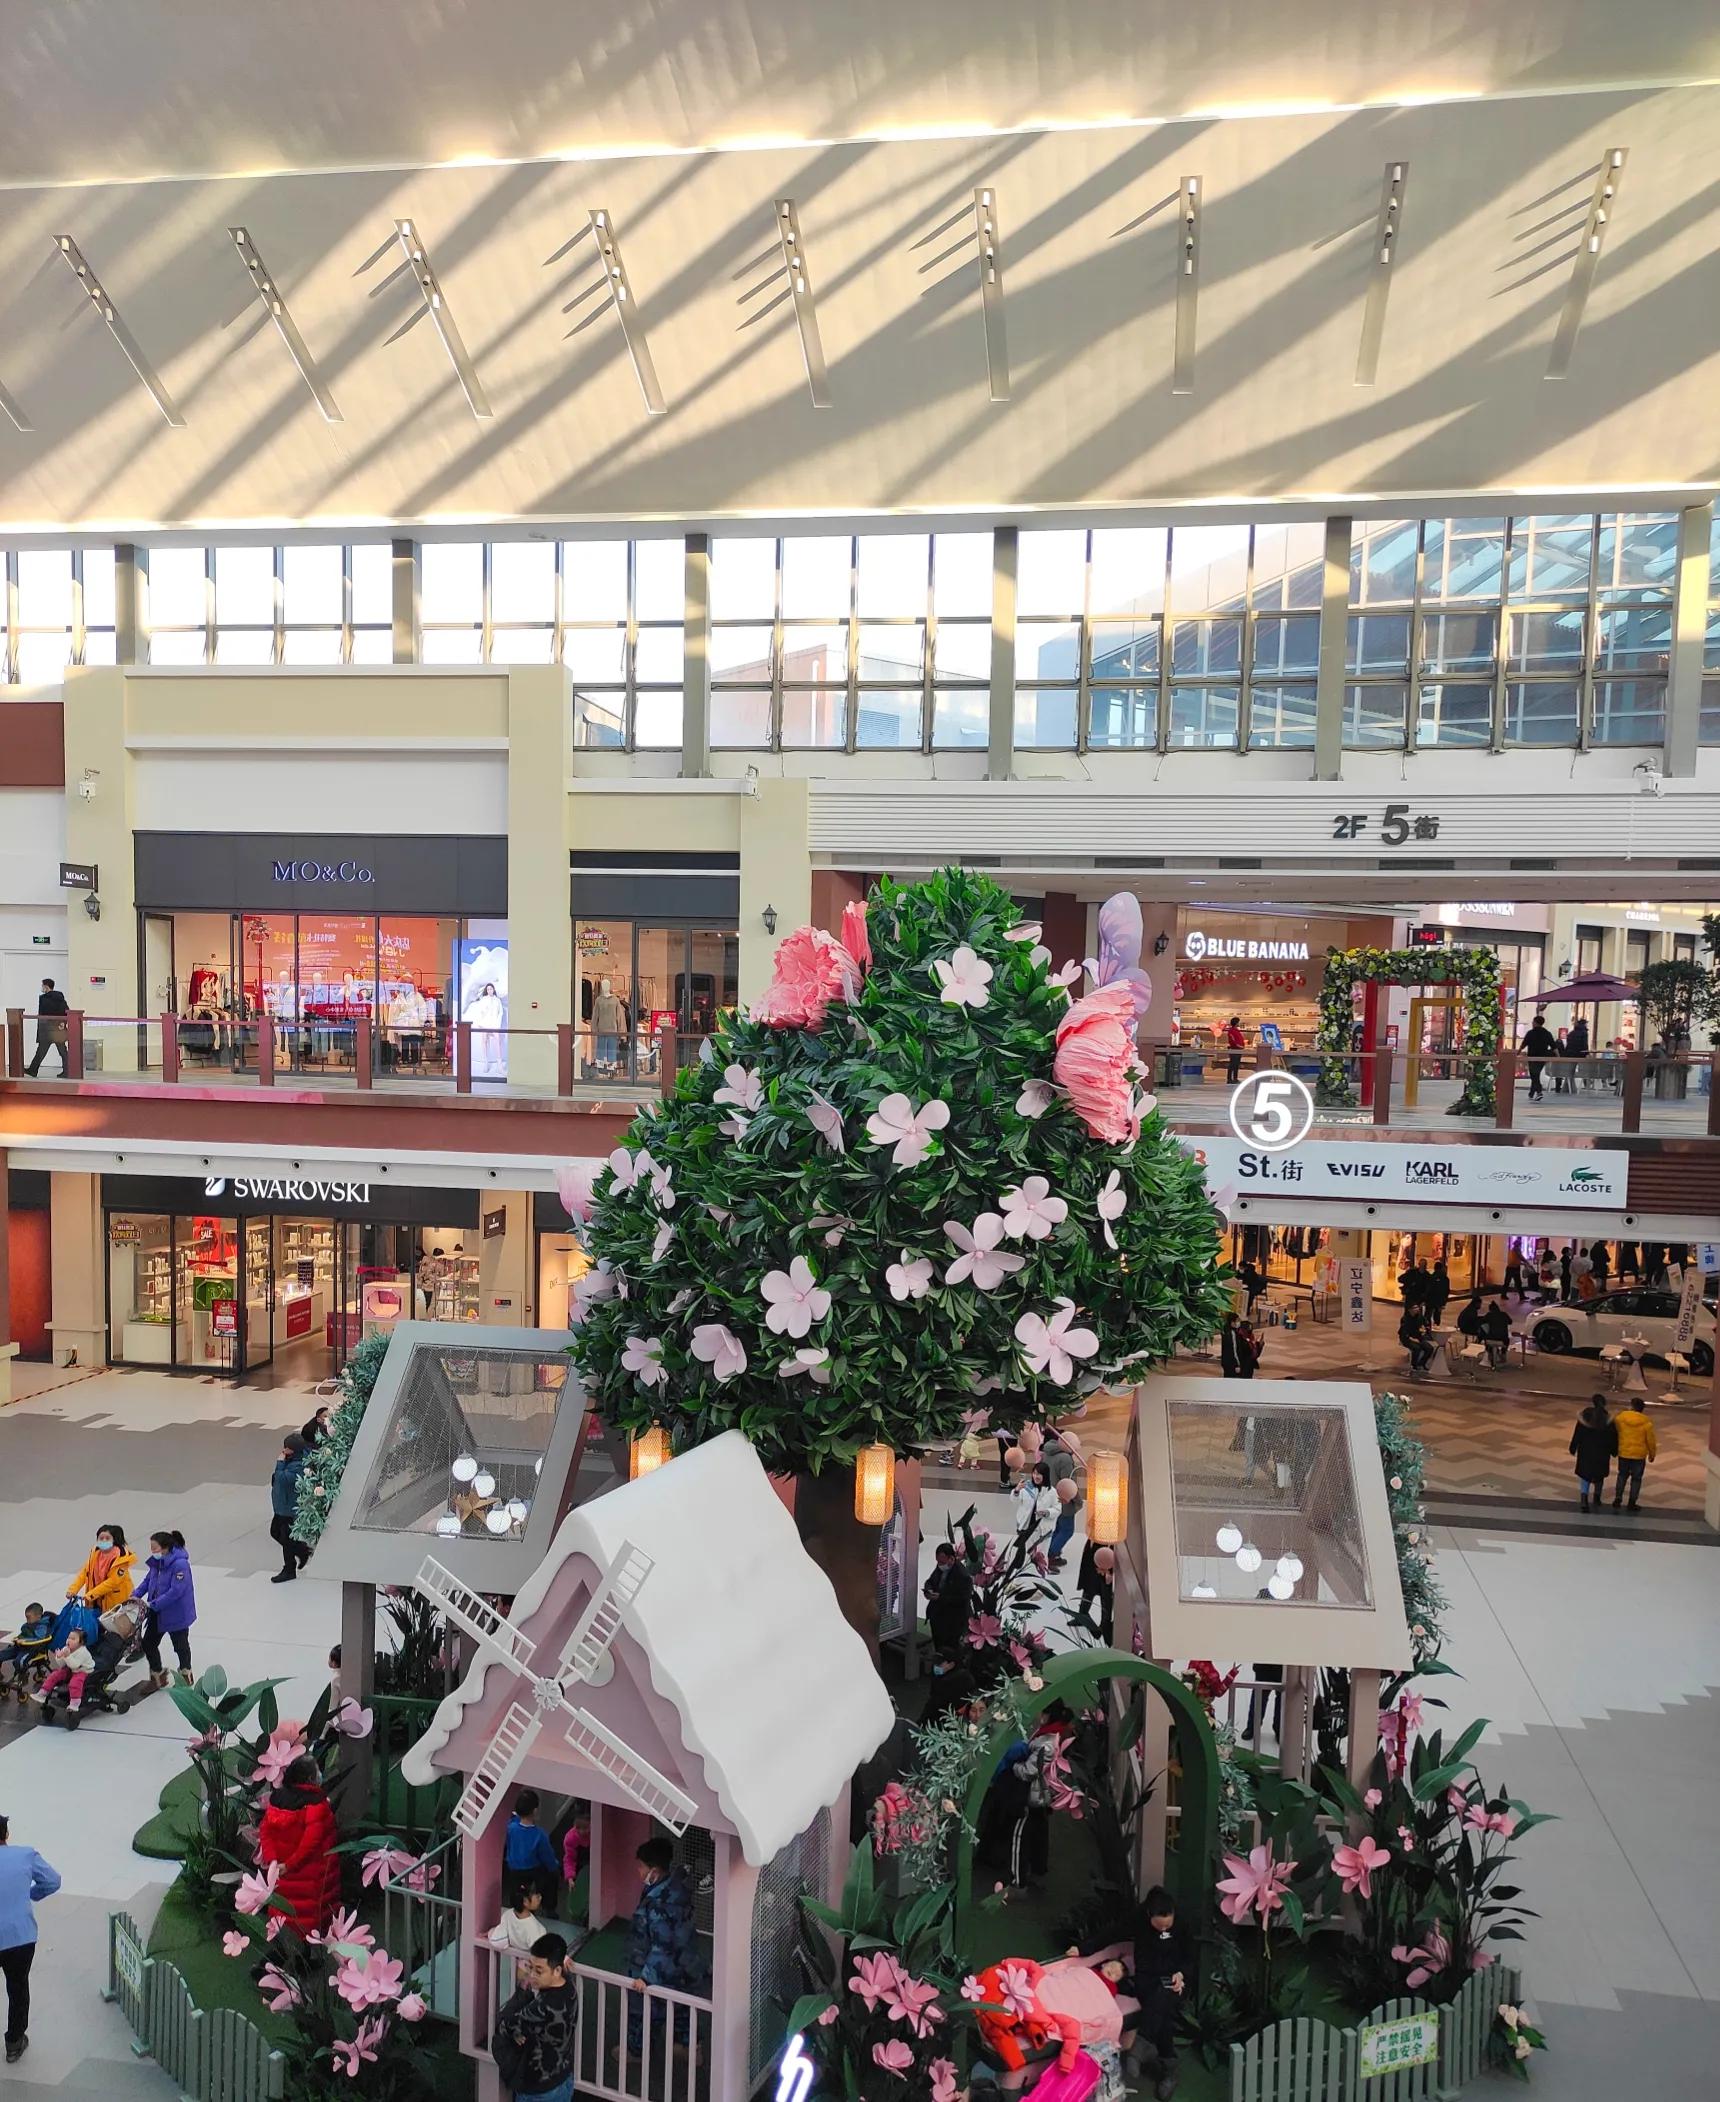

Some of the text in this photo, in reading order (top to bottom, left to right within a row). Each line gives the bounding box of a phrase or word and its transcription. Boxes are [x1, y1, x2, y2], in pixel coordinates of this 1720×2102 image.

[1333, 815, 1368, 839] 2F
[272, 860, 376, 883] MO&Co.
[1207, 938, 1310, 960] BLUE BANANA
[1251, 1082, 1293, 1142] 5
[1326, 1162, 1386, 1178] EVISU
[1405, 1160, 1460, 1178] KARL
[233, 1178, 371, 1203] SWAROVSKI
[1405, 1175, 1460, 1186] LAGERFELD
[1559, 1183, 1612, 1194] LACOSTE
[200, 1228, 214, 1240] SALE
[1375, 2042, 1423, 2066] 注意安全
